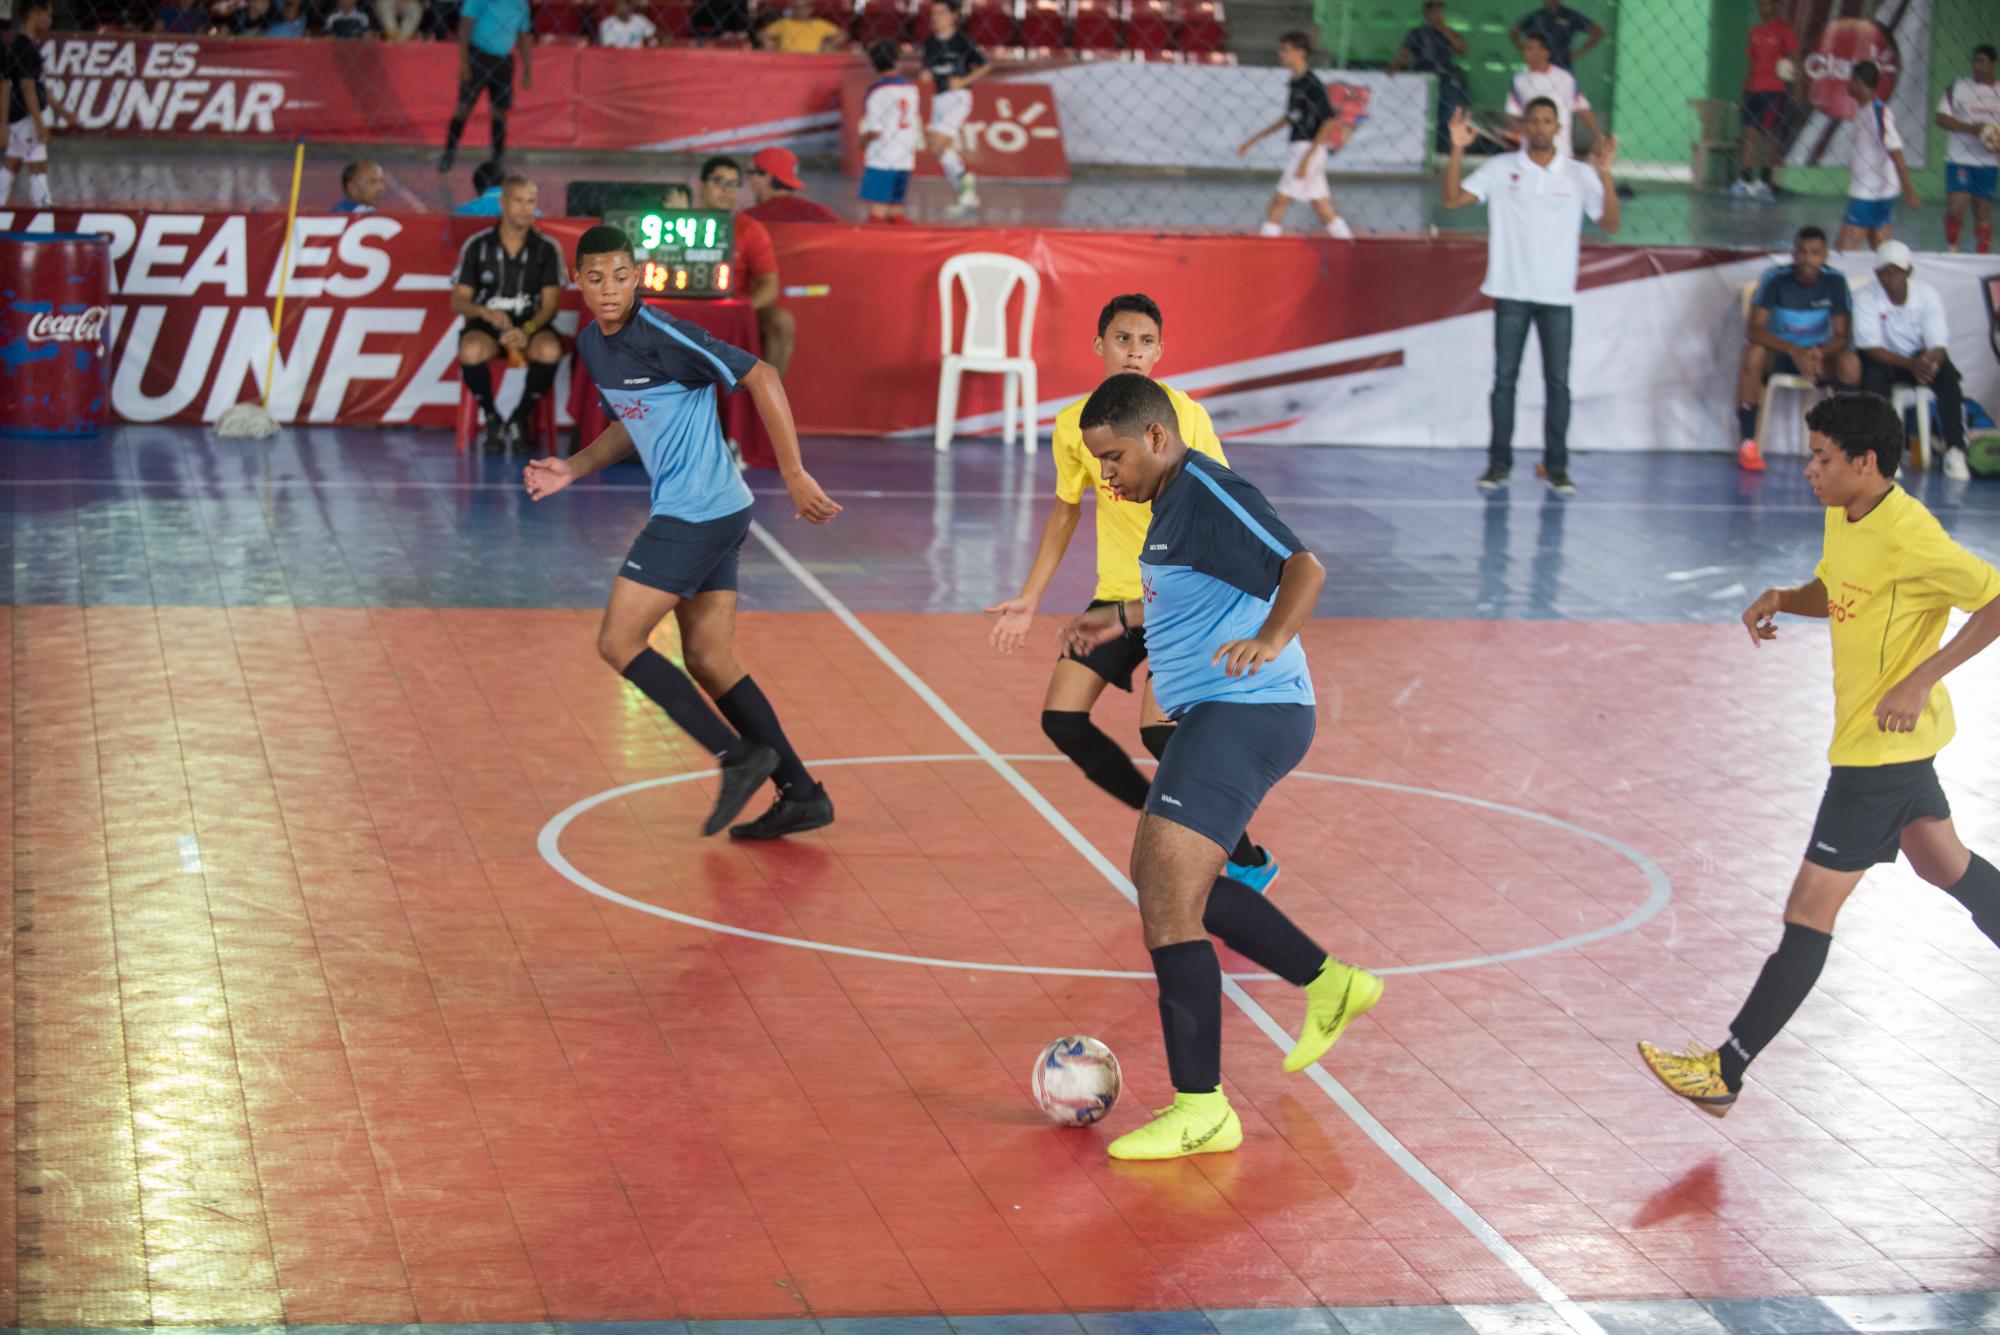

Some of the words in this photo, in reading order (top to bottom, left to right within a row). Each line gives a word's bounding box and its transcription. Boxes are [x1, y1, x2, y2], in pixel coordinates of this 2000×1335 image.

[143, 41, 200, 78] ES
[641, 214, 717, 249] 9:41
[265, 216, 403, 298] ES
